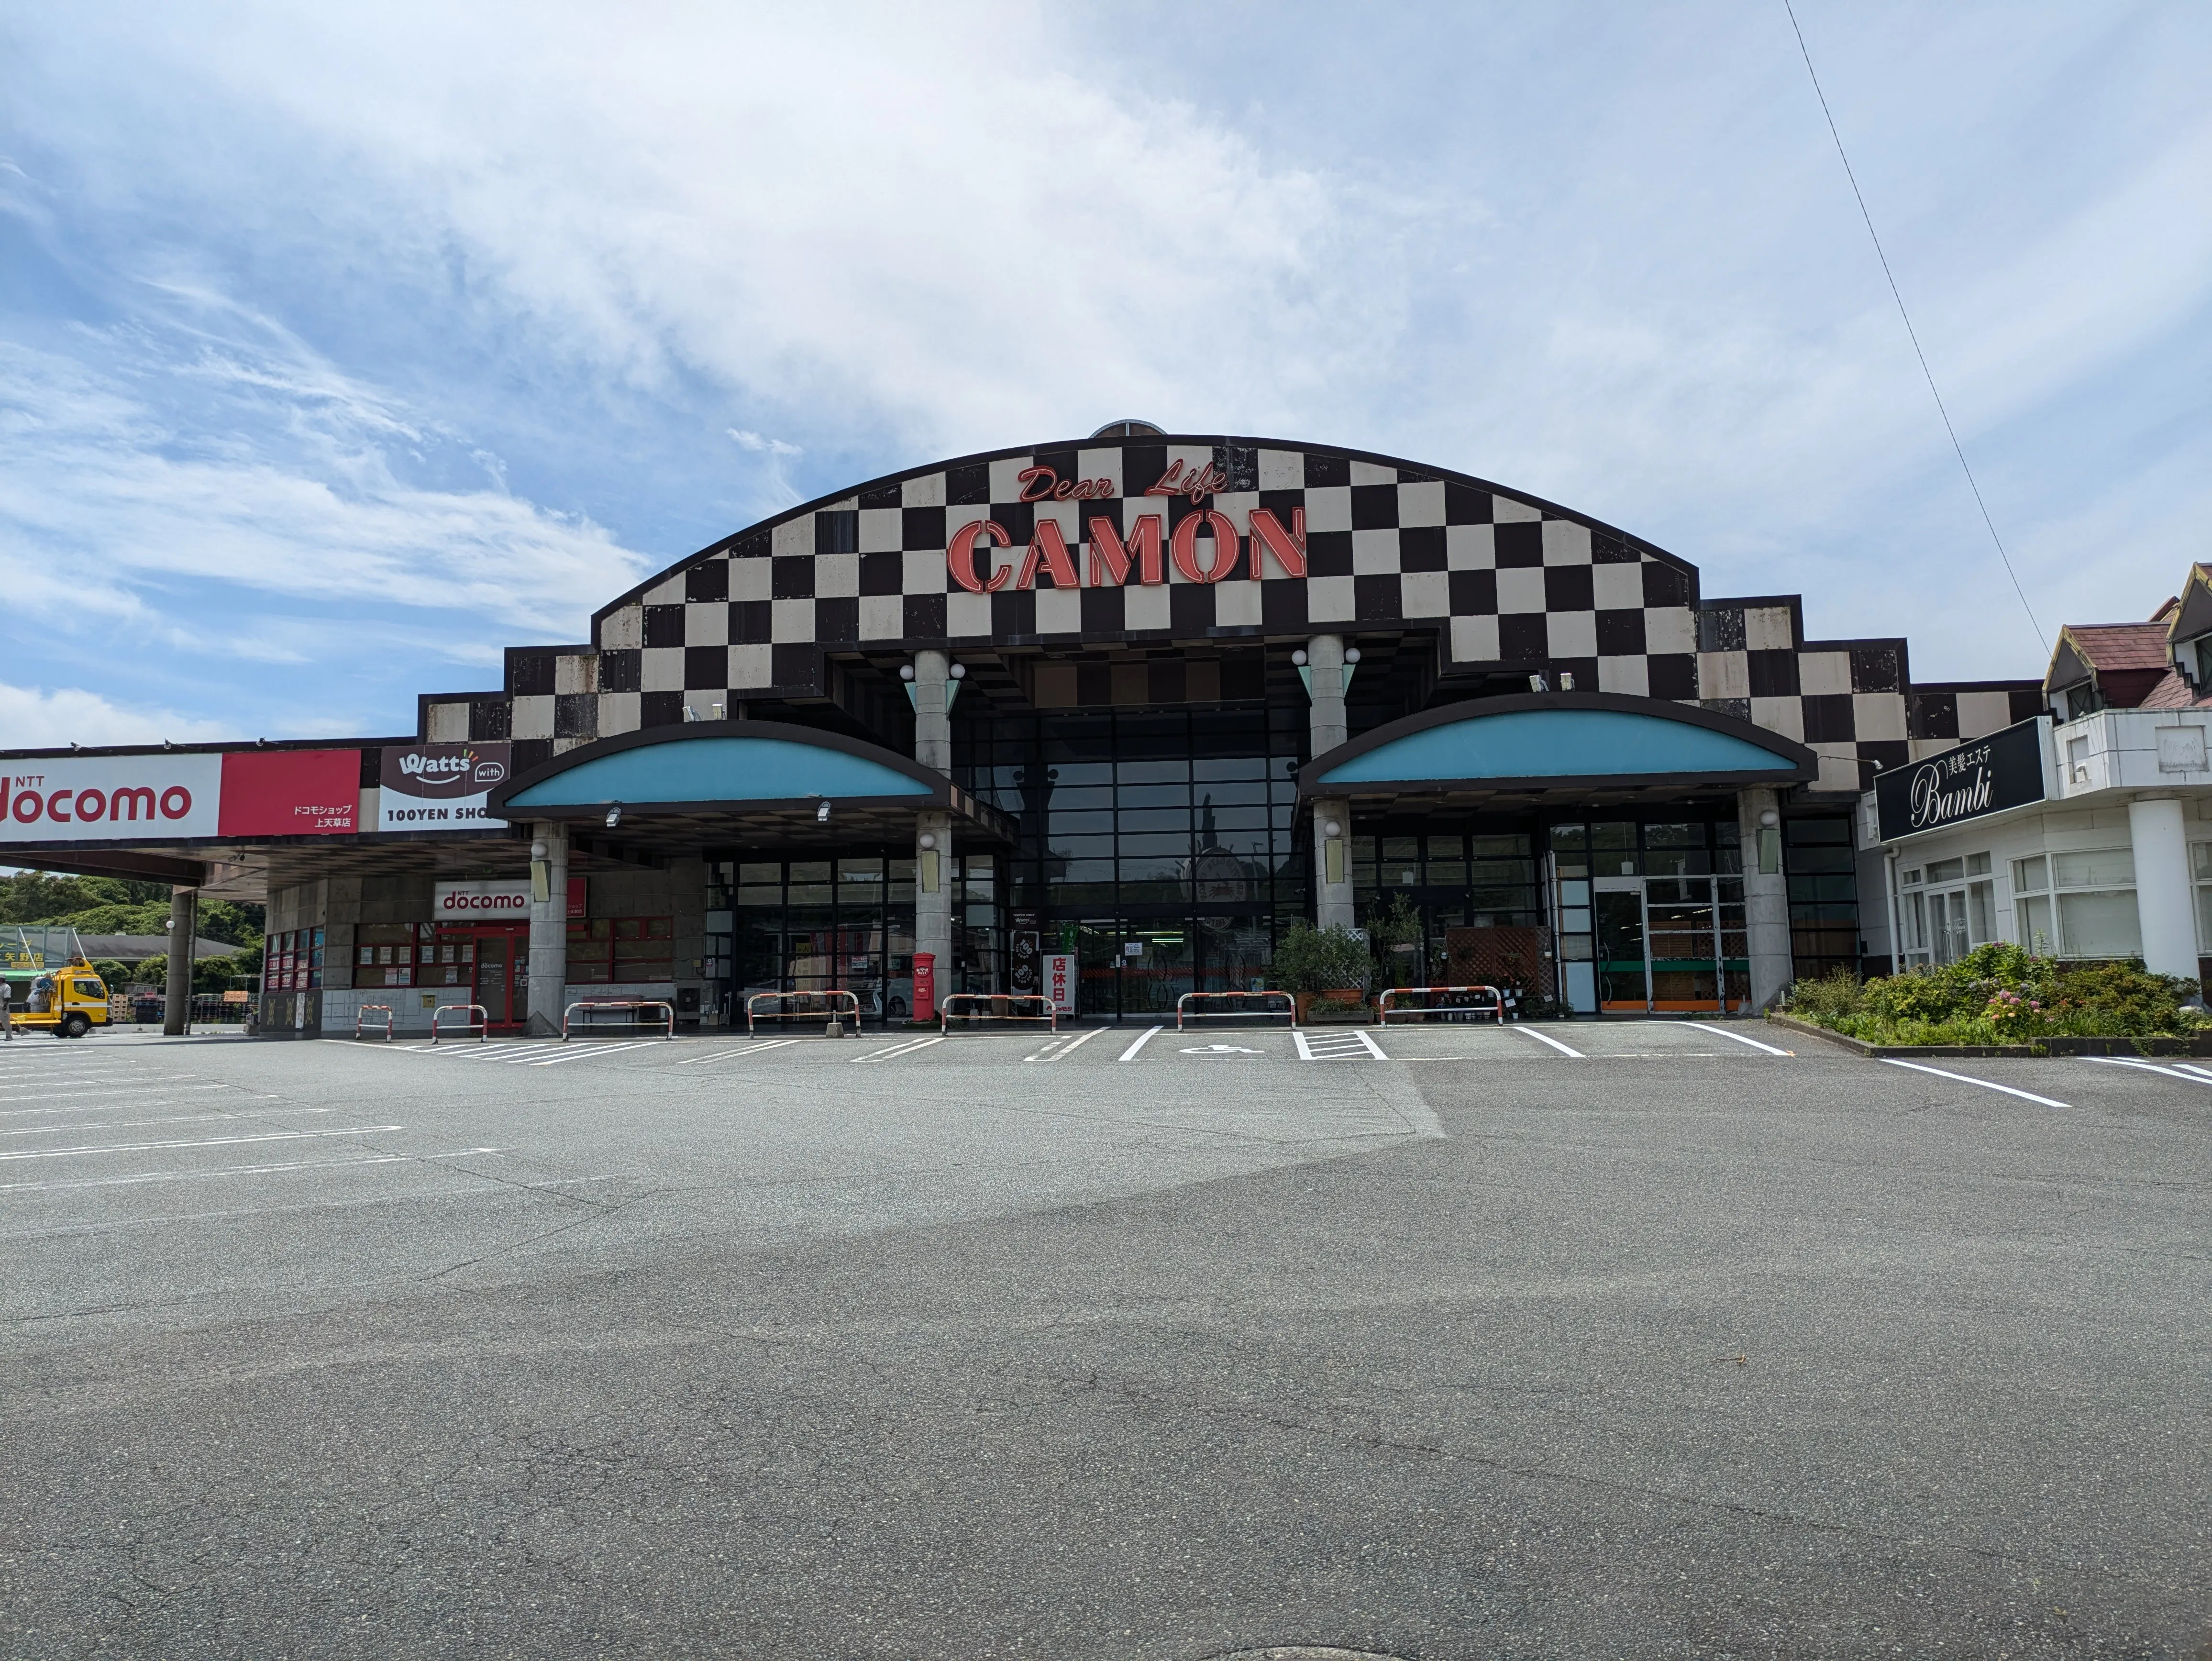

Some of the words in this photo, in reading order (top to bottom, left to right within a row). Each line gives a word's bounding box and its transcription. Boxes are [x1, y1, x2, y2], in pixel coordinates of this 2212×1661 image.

[1017, 465, 1115, 503] Dear
[1144, 458, 1230, 505] Life
[947, 506, 1307, 593] CAMON
[399, 753, 470, 775] Watts
[1948, 745, 1991, 776] 美髪エステ
[15, 776, 45, 787] NTT
[479, 767, 500, 776] with
[1911, 759, 1993, 828] Bambi
[295, 804, 352, 815] ドコモショップ
[388, 808, 448, 821] 100YEN
[455, 807, 487, 819] SHO
[314, 817, 352, 828] 上天草店
[443, 891, 525, 909] docomo
[1052, 957, 1066, 1002] 店休日
